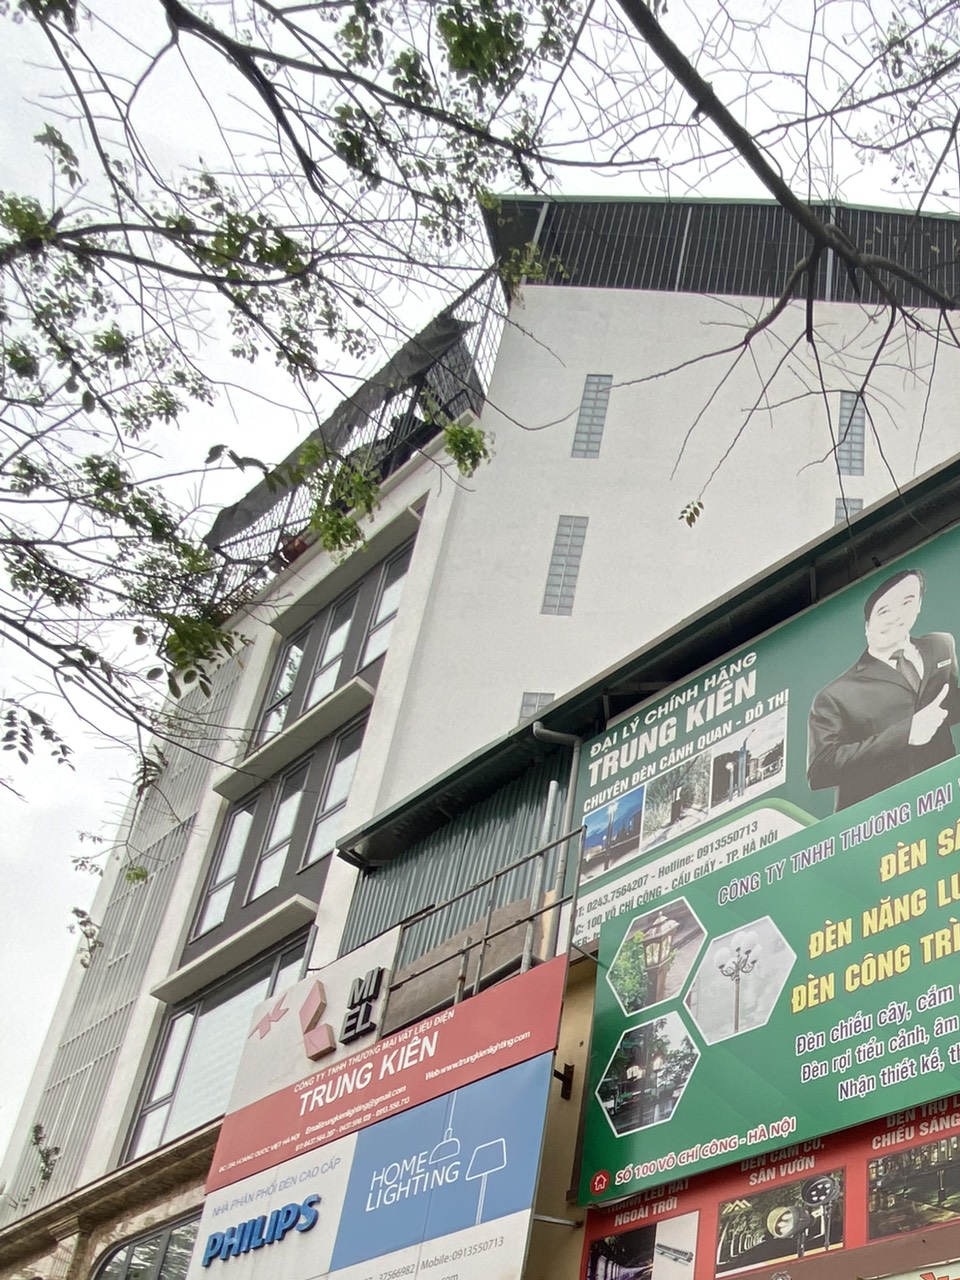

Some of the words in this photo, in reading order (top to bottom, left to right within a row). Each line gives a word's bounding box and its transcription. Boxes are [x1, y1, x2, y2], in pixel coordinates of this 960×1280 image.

[589, 717, 677, 787] TRUNG
[686, 669, 757, 733] KIÊN
[644, 686, 698, 724] CHÍNH
[583, 775, 628, 812] CHUYÊN
[632, 764, 656, 785] ĐÈN
[659, 744, 694, 769] CẢNH
[697, 720, 732, 749] QUAN
[745, 701, 764, 722] ĐÔ
[658, 854, 694, 878] Hotline:
[697, 821, 758, 860] 0913550713
[718, 872, 761, 906] CÔNG
[766, 859, 786, 884] TY
[791, 838, 835, 874] TNHH
[840, 804, 910, 850] THƯƠNG
[917, 784, 951, 817] MẠI
[880, 840, 927, 882] ĐÈN
[808, 918, 852, 959] ĐÈN
[862, 888, 927, 938] NĂNG
[791, 972, 835, 1014] ĐÈN
[845, 944, 911, 993] CÔNG
[796, 1033, 825, 1056] Đèn
[830, 1011, 872, 1043] chiếu
[877, 1001, 912, 1027] cây,
[917, 983, 953, 1012] cắm
[801, 1063, 828, 1083] Đèn
[856, 1037, 884, 1063] tiểu
[889, 1024, 929, 1053] cảnh,
[934, 1014, 958, 1037] âm
[299, 1062, 374, 1117] TRUNG
[379, 1031, 438, 1080] KIÊN
[838, 1075, 876, 1102] Nhận
[881, 1058, 917, 1087] thiết
[615, 1164, 633, 1185] SỐ
[635, 1159, 657, 1180] 100
[677, 1141, 701, 1167] CHÍ
[701, 1133, 739, 1159] CÔNG
[746, 1122, 768, 1144] HÀ
[769, 1115, 797, 1138] NỘI
[871, 1123, 915, 1150] CHIẾU
[919, 1111, 960, 1136] SÁNG
[365, 1161, 461, 1213] LIGHTING
[370, 1151, 428, 1191] HOME
[749, 1165, 776, 1186] SÂN
[778, 1156, 815, 1181] VƯỜN
[202, 1194, 322, 1268] PHILIPS
[614, 1205, 649, 1227] NGOÀI
